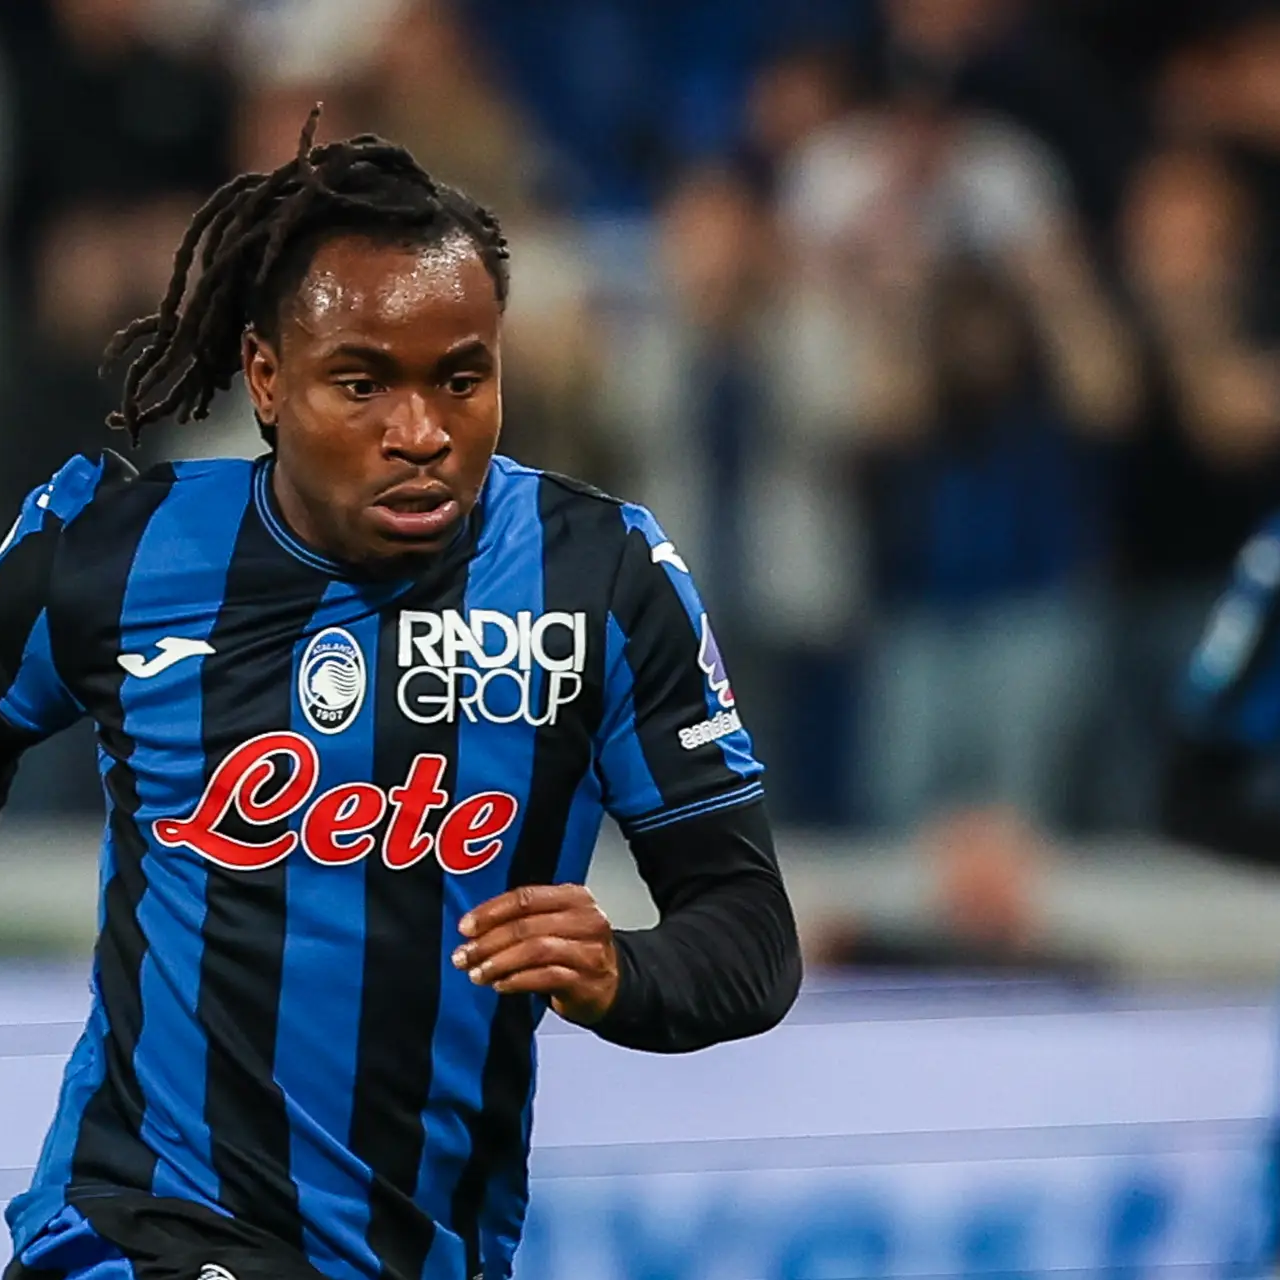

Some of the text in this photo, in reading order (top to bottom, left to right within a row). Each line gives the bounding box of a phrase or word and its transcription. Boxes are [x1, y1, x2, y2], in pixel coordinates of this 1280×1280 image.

[398, 609, 586, 672] RADICI
[316, 709, 344, 721] 1907
[397, 666, 582, 726] GROUP
[152, 730, 518, 874] Lete
